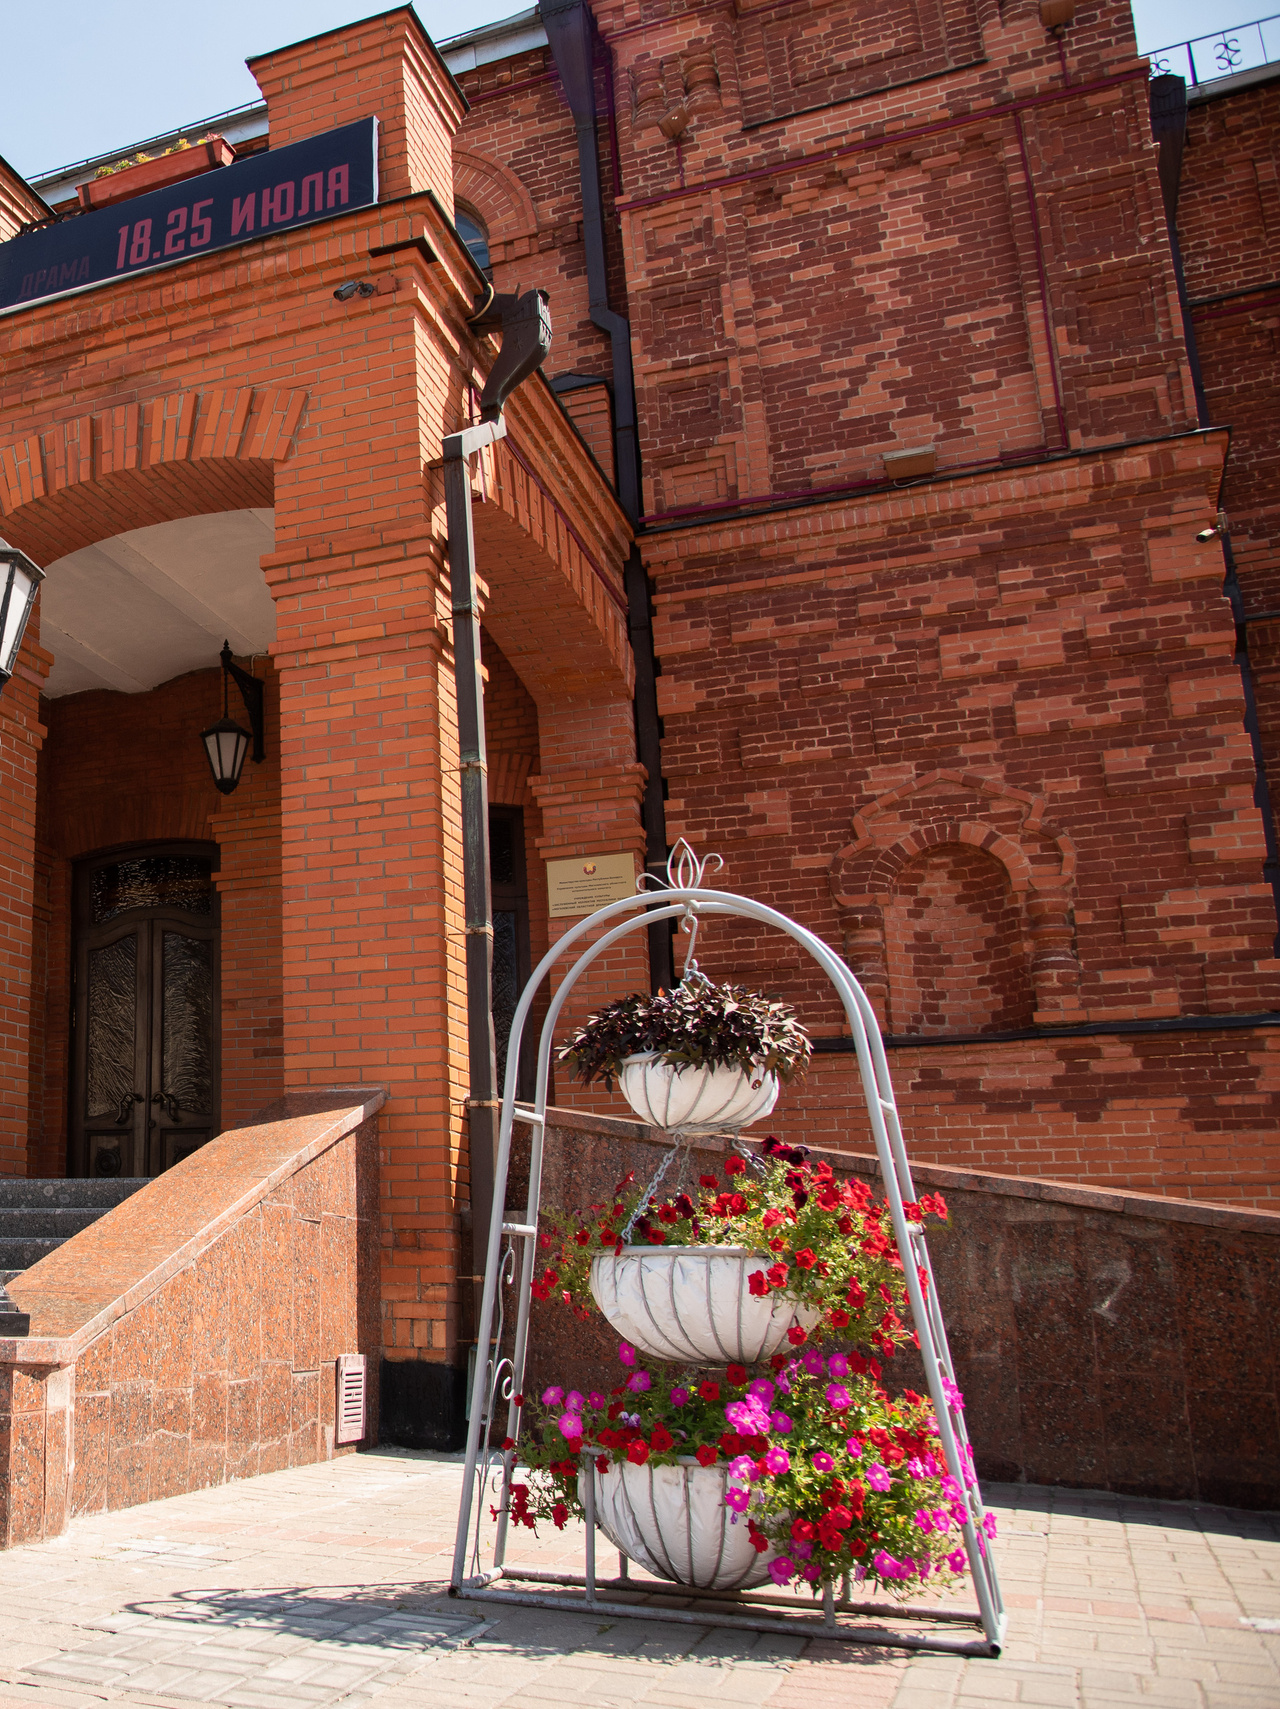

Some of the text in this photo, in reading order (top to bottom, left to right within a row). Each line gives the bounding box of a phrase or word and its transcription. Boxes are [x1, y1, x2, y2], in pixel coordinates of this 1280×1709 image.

[115, 163, 350, 270] 18.25 ИЮЛЯ
[19, 255, 90, 300] ДРАМА
